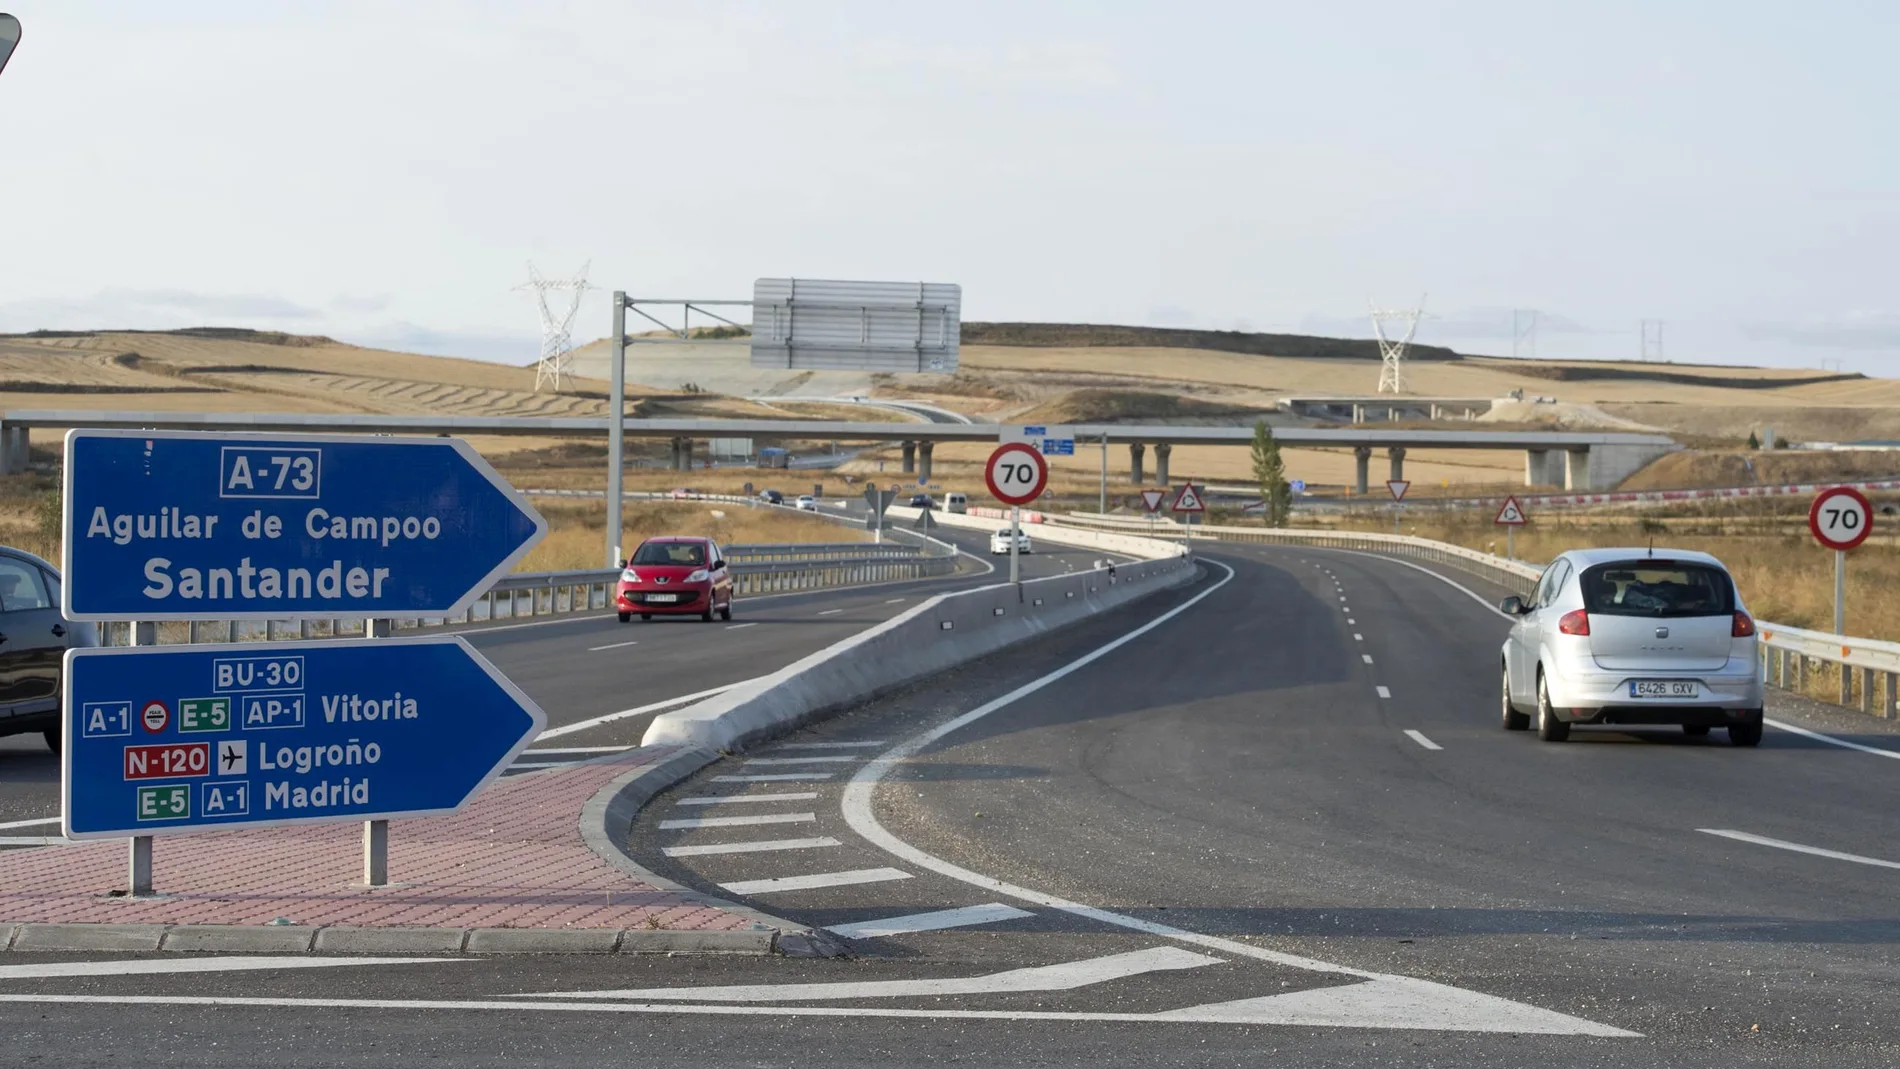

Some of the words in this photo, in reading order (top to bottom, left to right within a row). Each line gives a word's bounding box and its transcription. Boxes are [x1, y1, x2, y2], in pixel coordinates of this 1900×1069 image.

[228, 456, 314, 490] A-73
[1001, 464, 1033, 484] 70
[87, 506, 218, 545] Aguilar
[242, 510, 282, 539] de
[306, 508, 441, 547] Campoo
[1826, 509, 1858, 529] 70
[143, 557, 390, 599] Santander
[219, 662, 300, 687] BU-30
[1639, 683, 1666, 693] 6426
[1673, 683, 1693, 693] GXV
[89, 707, 128, 732] A-1
[183, 703, 226, 728] E-5
[248, 700, 301, 724] AP-1
[322, 692, 419, 723] Vitoria
[129, 748, 205, 775] N-120
[260, 739, 381, 774] Logroño
[142, 790, 186, 815] E-5
[207, 786, 245, 811] A-1
[266, 777, 369, 810] Madrid
